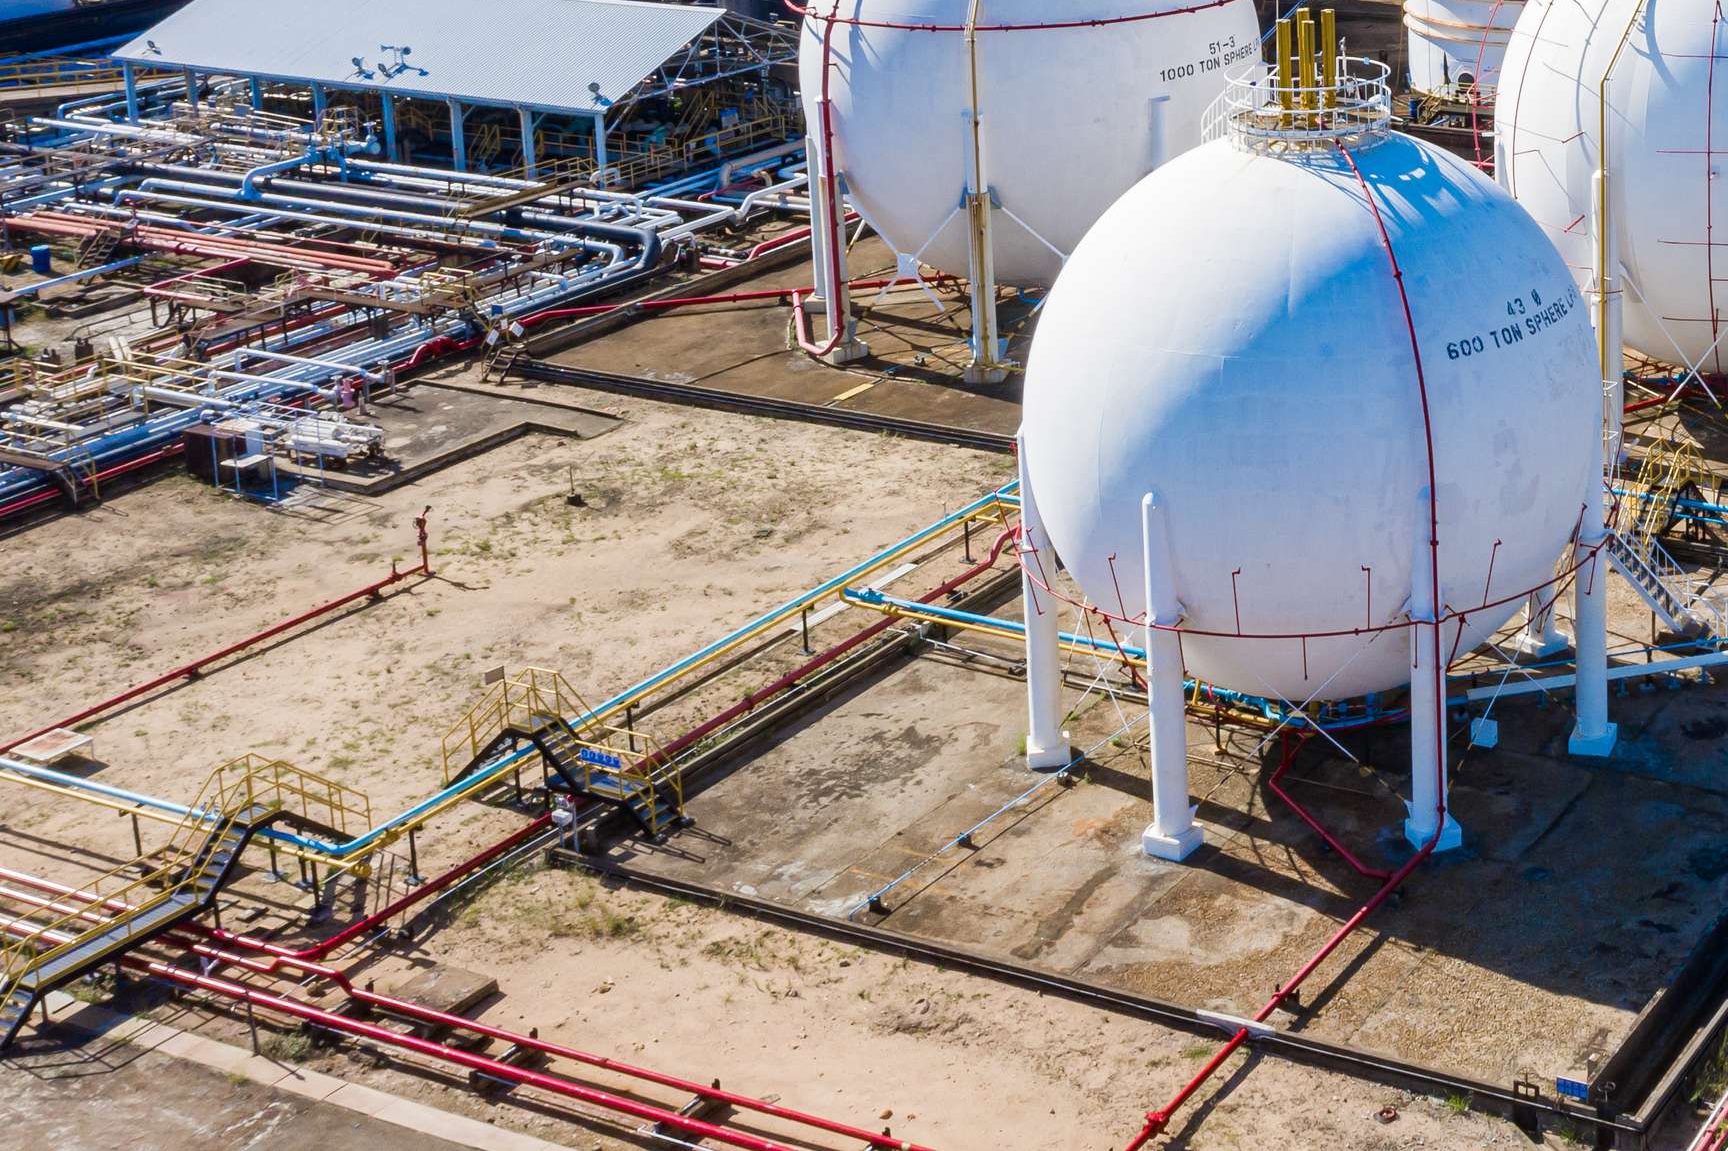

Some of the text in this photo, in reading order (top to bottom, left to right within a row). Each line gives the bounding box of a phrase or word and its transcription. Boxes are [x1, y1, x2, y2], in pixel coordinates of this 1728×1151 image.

[1160, 64, 1195, 82] 1000
[1199, 57, 1221, 73] TON
[1224, 43, 1253, 66] SPHERE
[1507, 297, 1526, 316] 43
[1446, 335, 1485, 361] 600
[1489, 323, 1524, 349] TON
[1525, 300, 1568, 336] SPHERE
